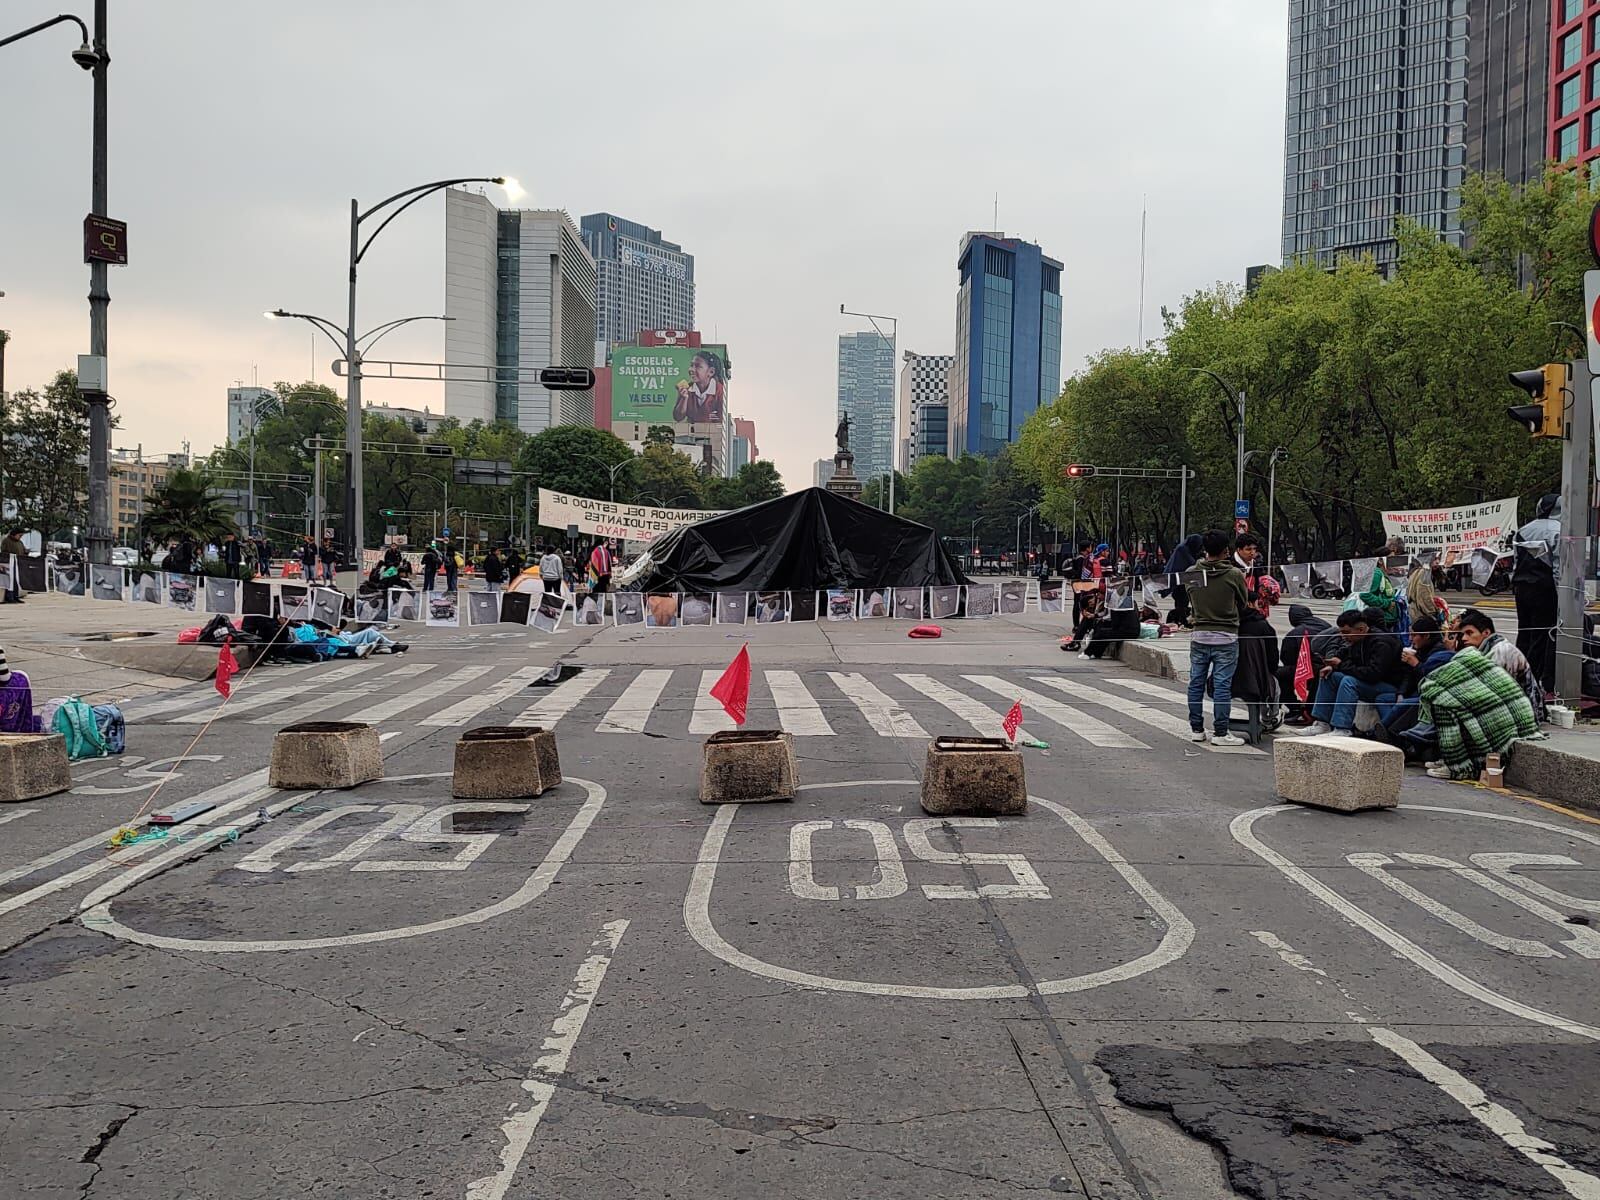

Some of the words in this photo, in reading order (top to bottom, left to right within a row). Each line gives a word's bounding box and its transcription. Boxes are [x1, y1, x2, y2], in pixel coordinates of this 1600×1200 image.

[625, 356, 673, 366] ESCUELAS
[619, 366, 680, 376] SALUDABLES
[629, 393, 640, 403] YA
[641, 393, 651, 403] ES
[652, 393, 667, 403] LEY
[1387, 512, 1449, 523] MANIFESTARSE
[1452, 511, 1463, 521] ES
[1465, 509, 1477, 518] UN
[1479, 504, 1502, 517] ACTO
[1400, 524, 1410, 533] DE
[1412, 523, 1454, 534] LIBERTAD
[1456, 520, 1478, 532] PERO
[1403, 535, 1444, 545] GOBIERNO
[1446, 534, 1462, 543] NOS
[234, 803, 531, 873] 50
[788, 817, 1052, 901] 50
